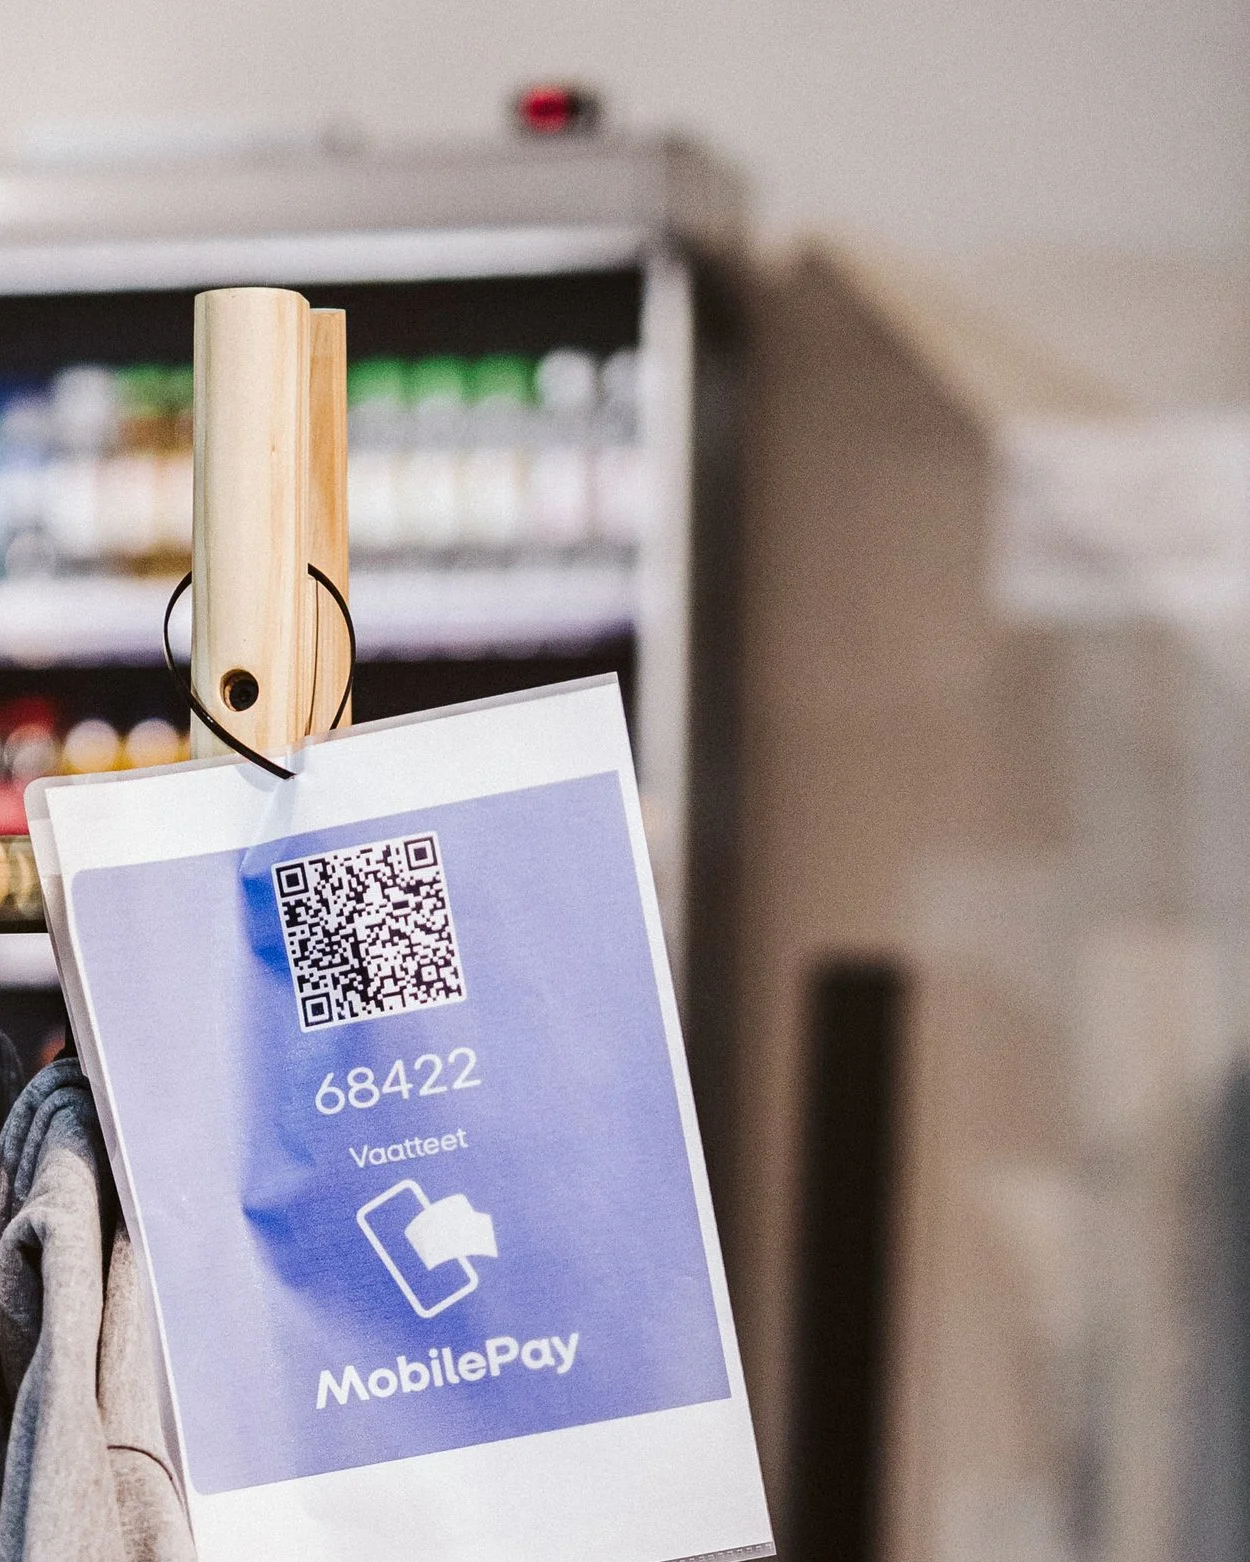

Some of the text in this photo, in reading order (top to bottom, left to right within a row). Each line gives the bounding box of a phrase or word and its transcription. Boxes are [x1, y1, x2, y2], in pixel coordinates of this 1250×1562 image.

[314, 1047, 482, 1115] 68422
[348, 1128, 469, 1169] Vaatteet
[315, 1332, 579, 1410] MobilePay
